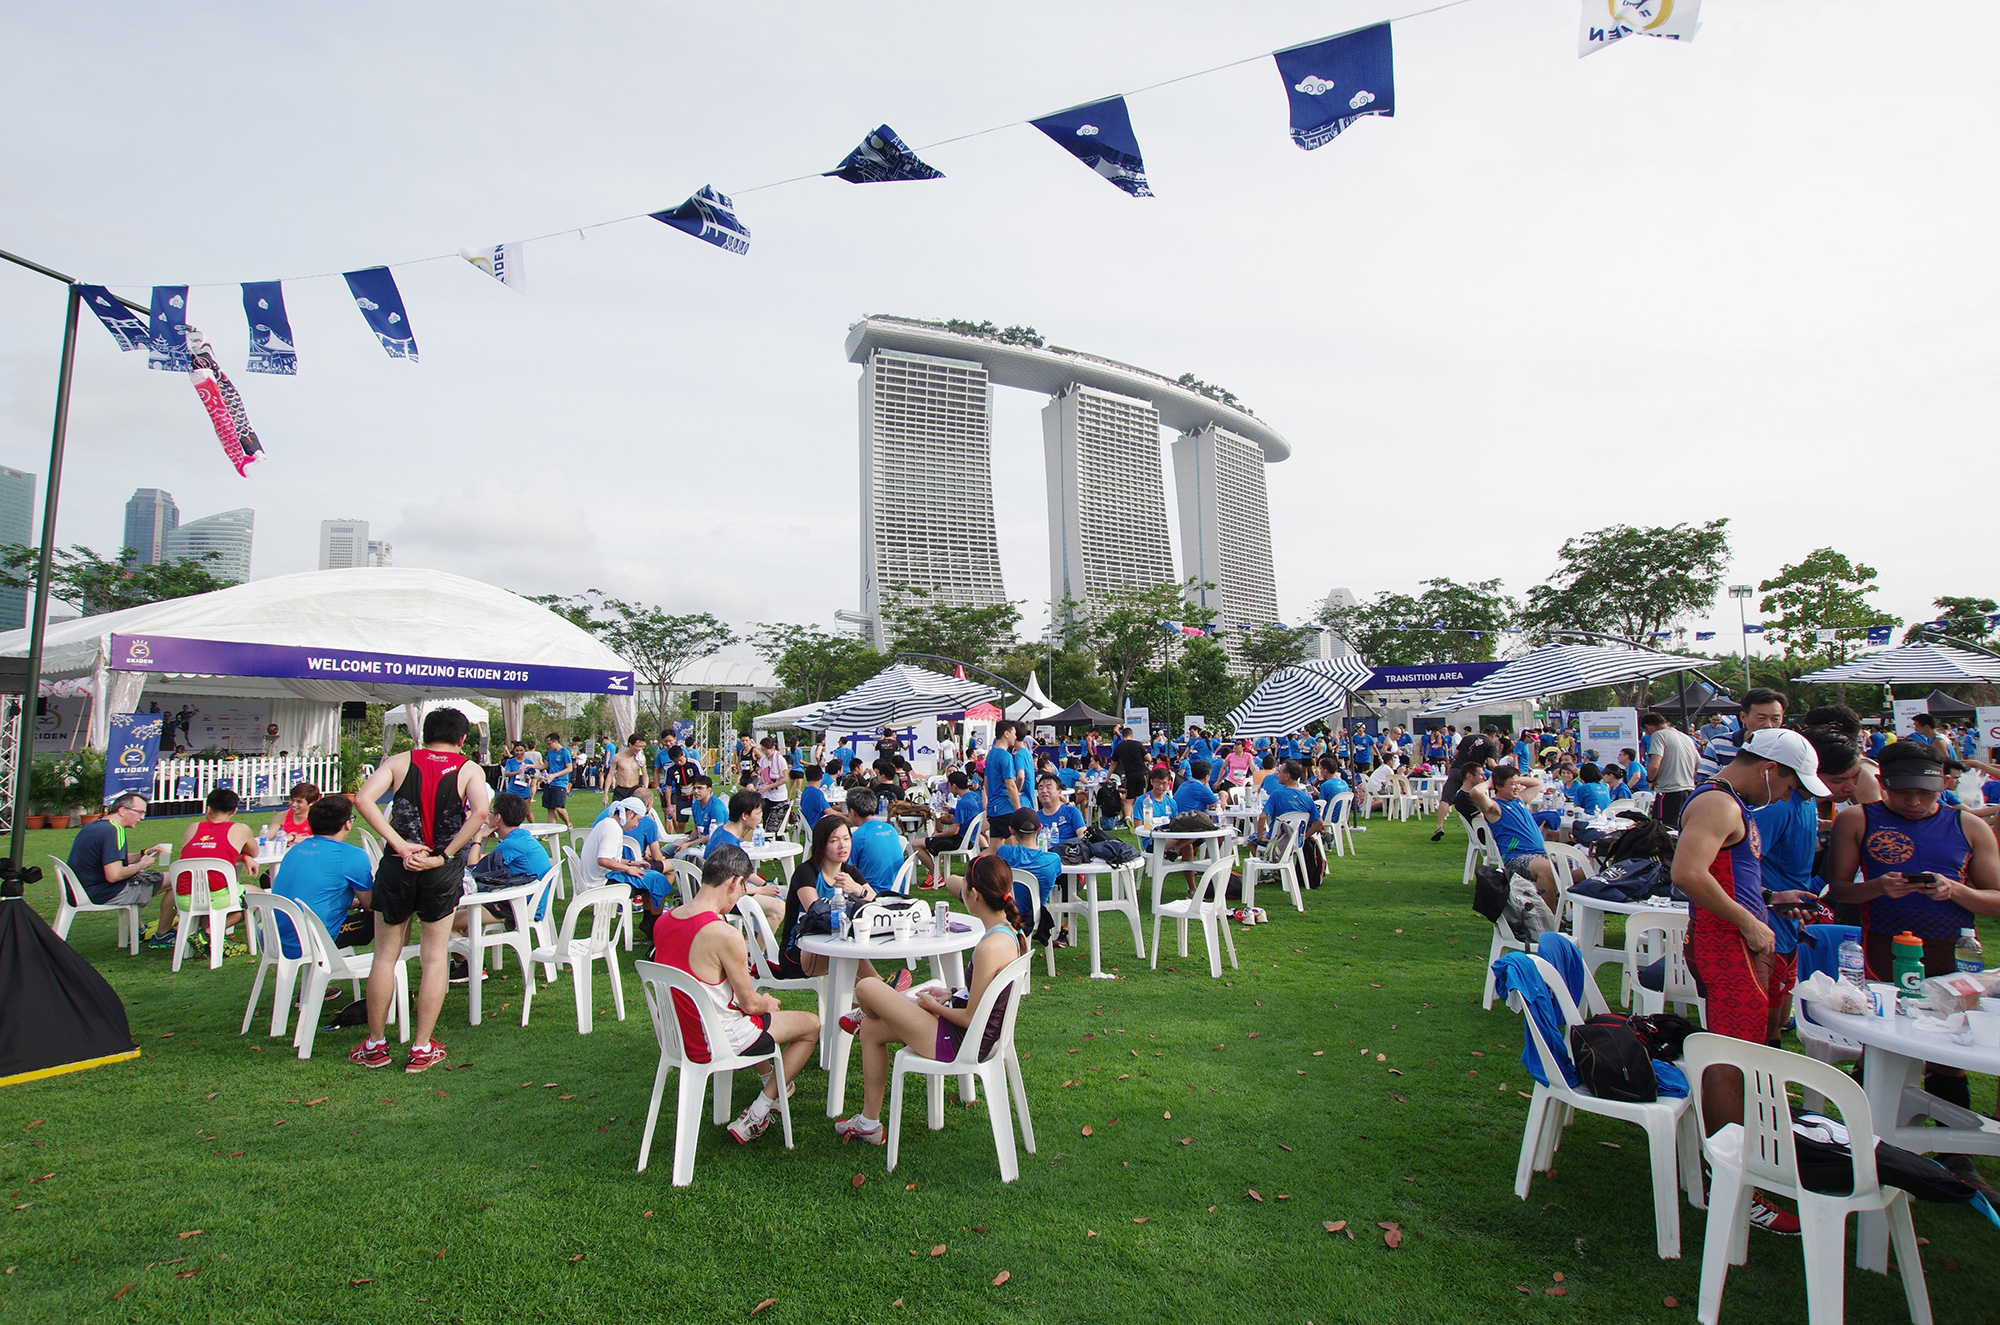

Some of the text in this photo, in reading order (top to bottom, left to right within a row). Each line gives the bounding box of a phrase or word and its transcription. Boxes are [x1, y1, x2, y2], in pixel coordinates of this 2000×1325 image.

[307, 657, 529, 682] WELCOME TO MIZUNO EKIDEN 2015
[1385, 671, 1464, 683] TRANSITION AREA
[114, 766, 150, 774] EKIDEN
